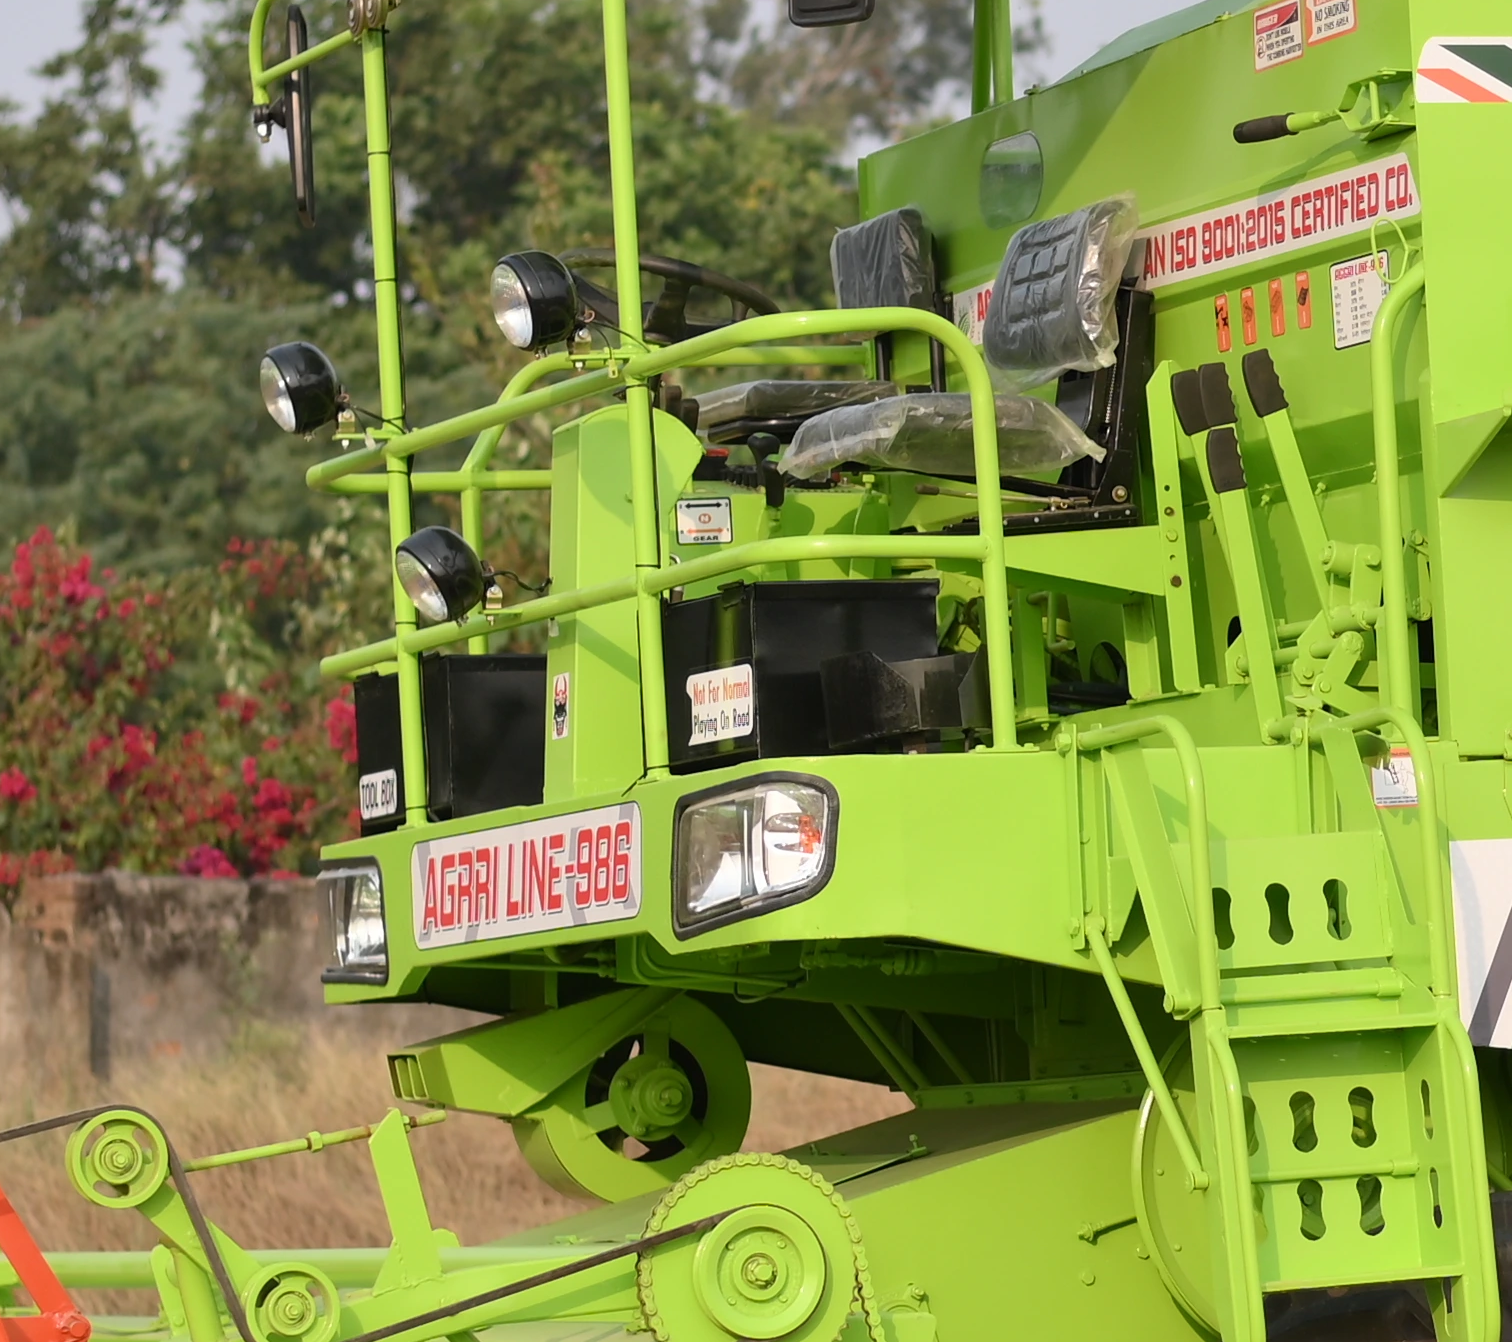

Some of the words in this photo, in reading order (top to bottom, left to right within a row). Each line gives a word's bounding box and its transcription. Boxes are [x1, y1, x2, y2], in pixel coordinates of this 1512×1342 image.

[1315, 9, 1323, 23] NO
[1143, 235, 1166, 281] AN
[1171, 226, 1197, 273] ISO
[1202, 200, 1285, 265] 9001:2015
[1291, 172, 1379, 239] CERTIFIED
[1385, 163, 1413, 213] CO.
[693, 683, 705, 707] Not
[708, 679, 719, 704] For
[723, 670, 750, 701] Normal
[720, 709, 730, 730] On
[361, 781, 378, 810] TOOL
[381, 778, 394, 806] BOX
[423, 845, 500, 934] AGRRI
[506, 821, 632, 922] LINE-986
